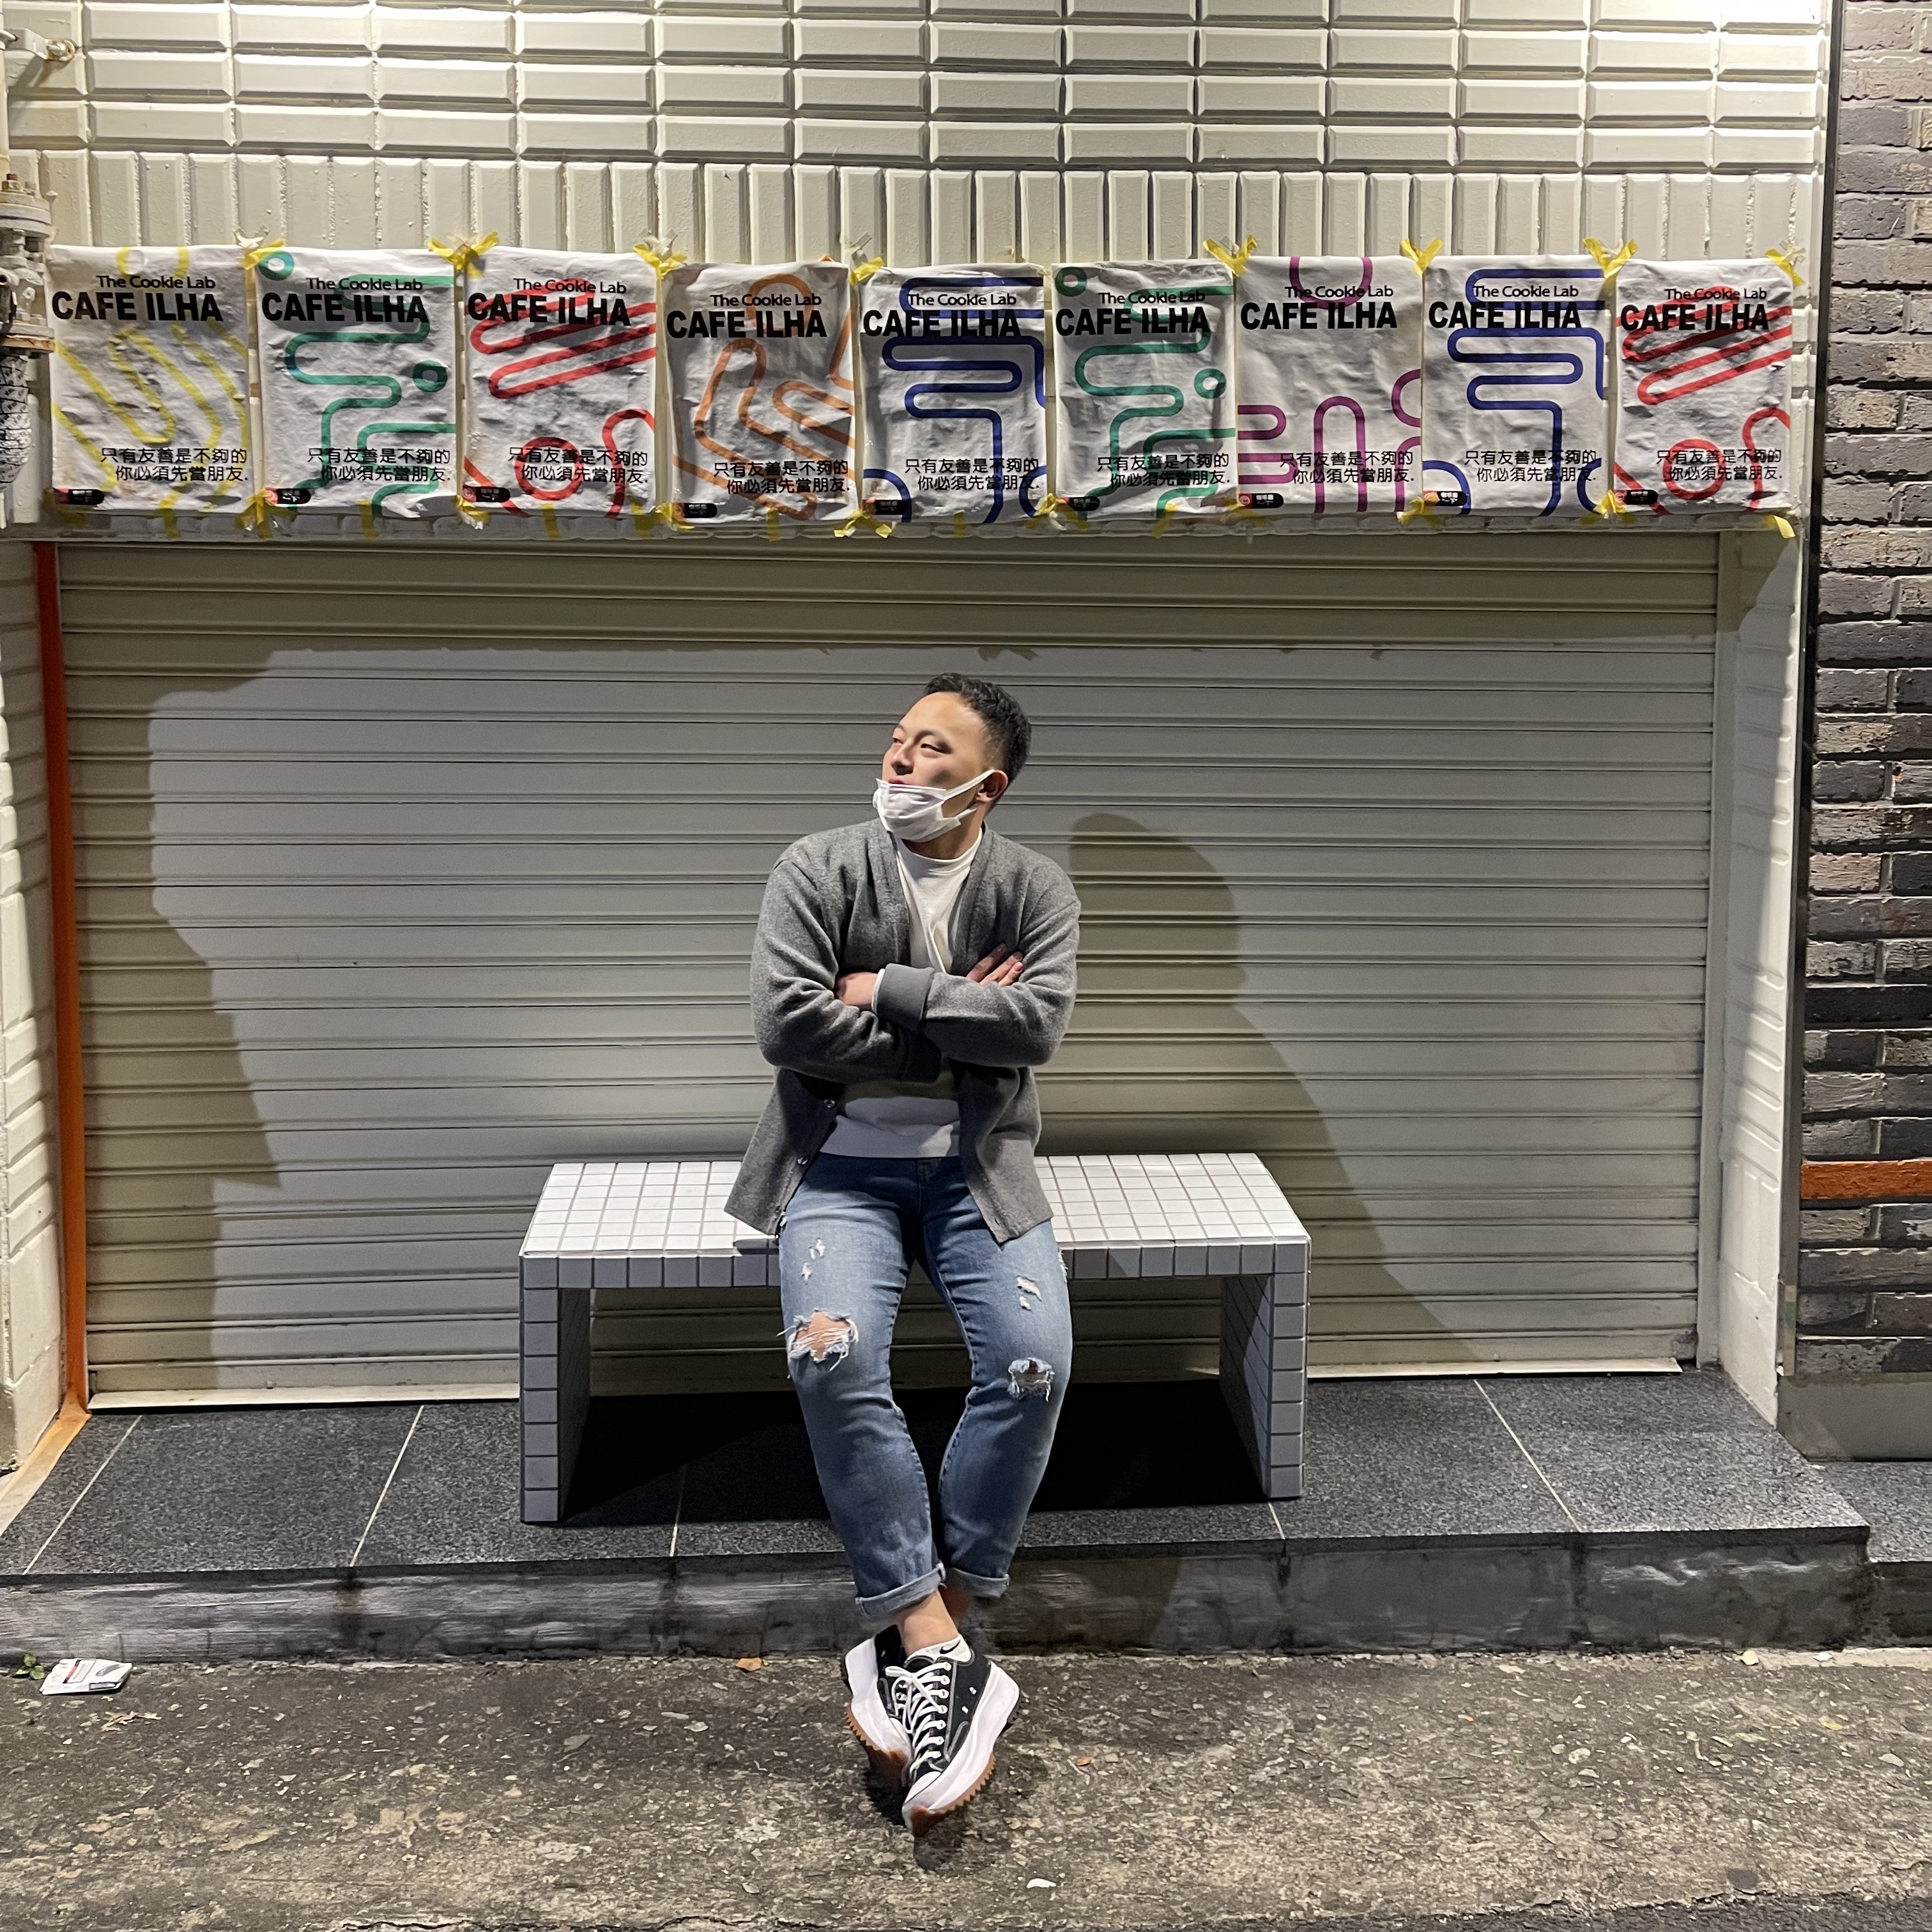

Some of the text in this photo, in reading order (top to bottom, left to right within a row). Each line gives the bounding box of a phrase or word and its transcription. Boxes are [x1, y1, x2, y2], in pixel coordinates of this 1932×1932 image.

[96, 275, 215, 289] The Cookie Lab
[306, 277, 423, 291] The Cookie Lab
[513, 279, 627, 293] The Cookie Lab
[1098, 291, 1206, 304] The Cookie Lab
[1284, 285, 1393, 298] The Cookie Lab
[1473, 285, 1579, 297] The Cookie Lab
[1664, 288, 1767, 300] The Cookie Lab
[52, 291, 224, 321] CAFE ILHA
[710, 293, 822, 306] The Cookie Lab
[907, 294, 1016, 305] The Cookie Lab
[262, 293, 429, 323] CAFE ILHA
[468, 293, 631, 326] CAFE ILHA
[1240, 302, 1397, 330] CAFE ILHA
[1429, 301, 1581, 328] CAFE ILHA
[666, 310, 827, 338] CAFE ILHA
[863, 310, 1021, 337] CAFE ILHA
[1055, 306, 1210, 336] CAFE ILHA
[1620, 304, 1768, 331] CAFE ILHA
[100, 448, 247, 463] 只有友善是不夠的
[307, 448, 450, 464] 只有友善是不夠的
[509, 447, 647, 466] 只有友善是不夠的
[1098, 453, 1229, 471] 只有友善是不夠的
[1280, 451, 1413, 467] 只有友善是不夠的
[1657, 449, 1781, 464] 只有友善是不夠的
[714, 459, 848, 477] 只有友善是不夠的
